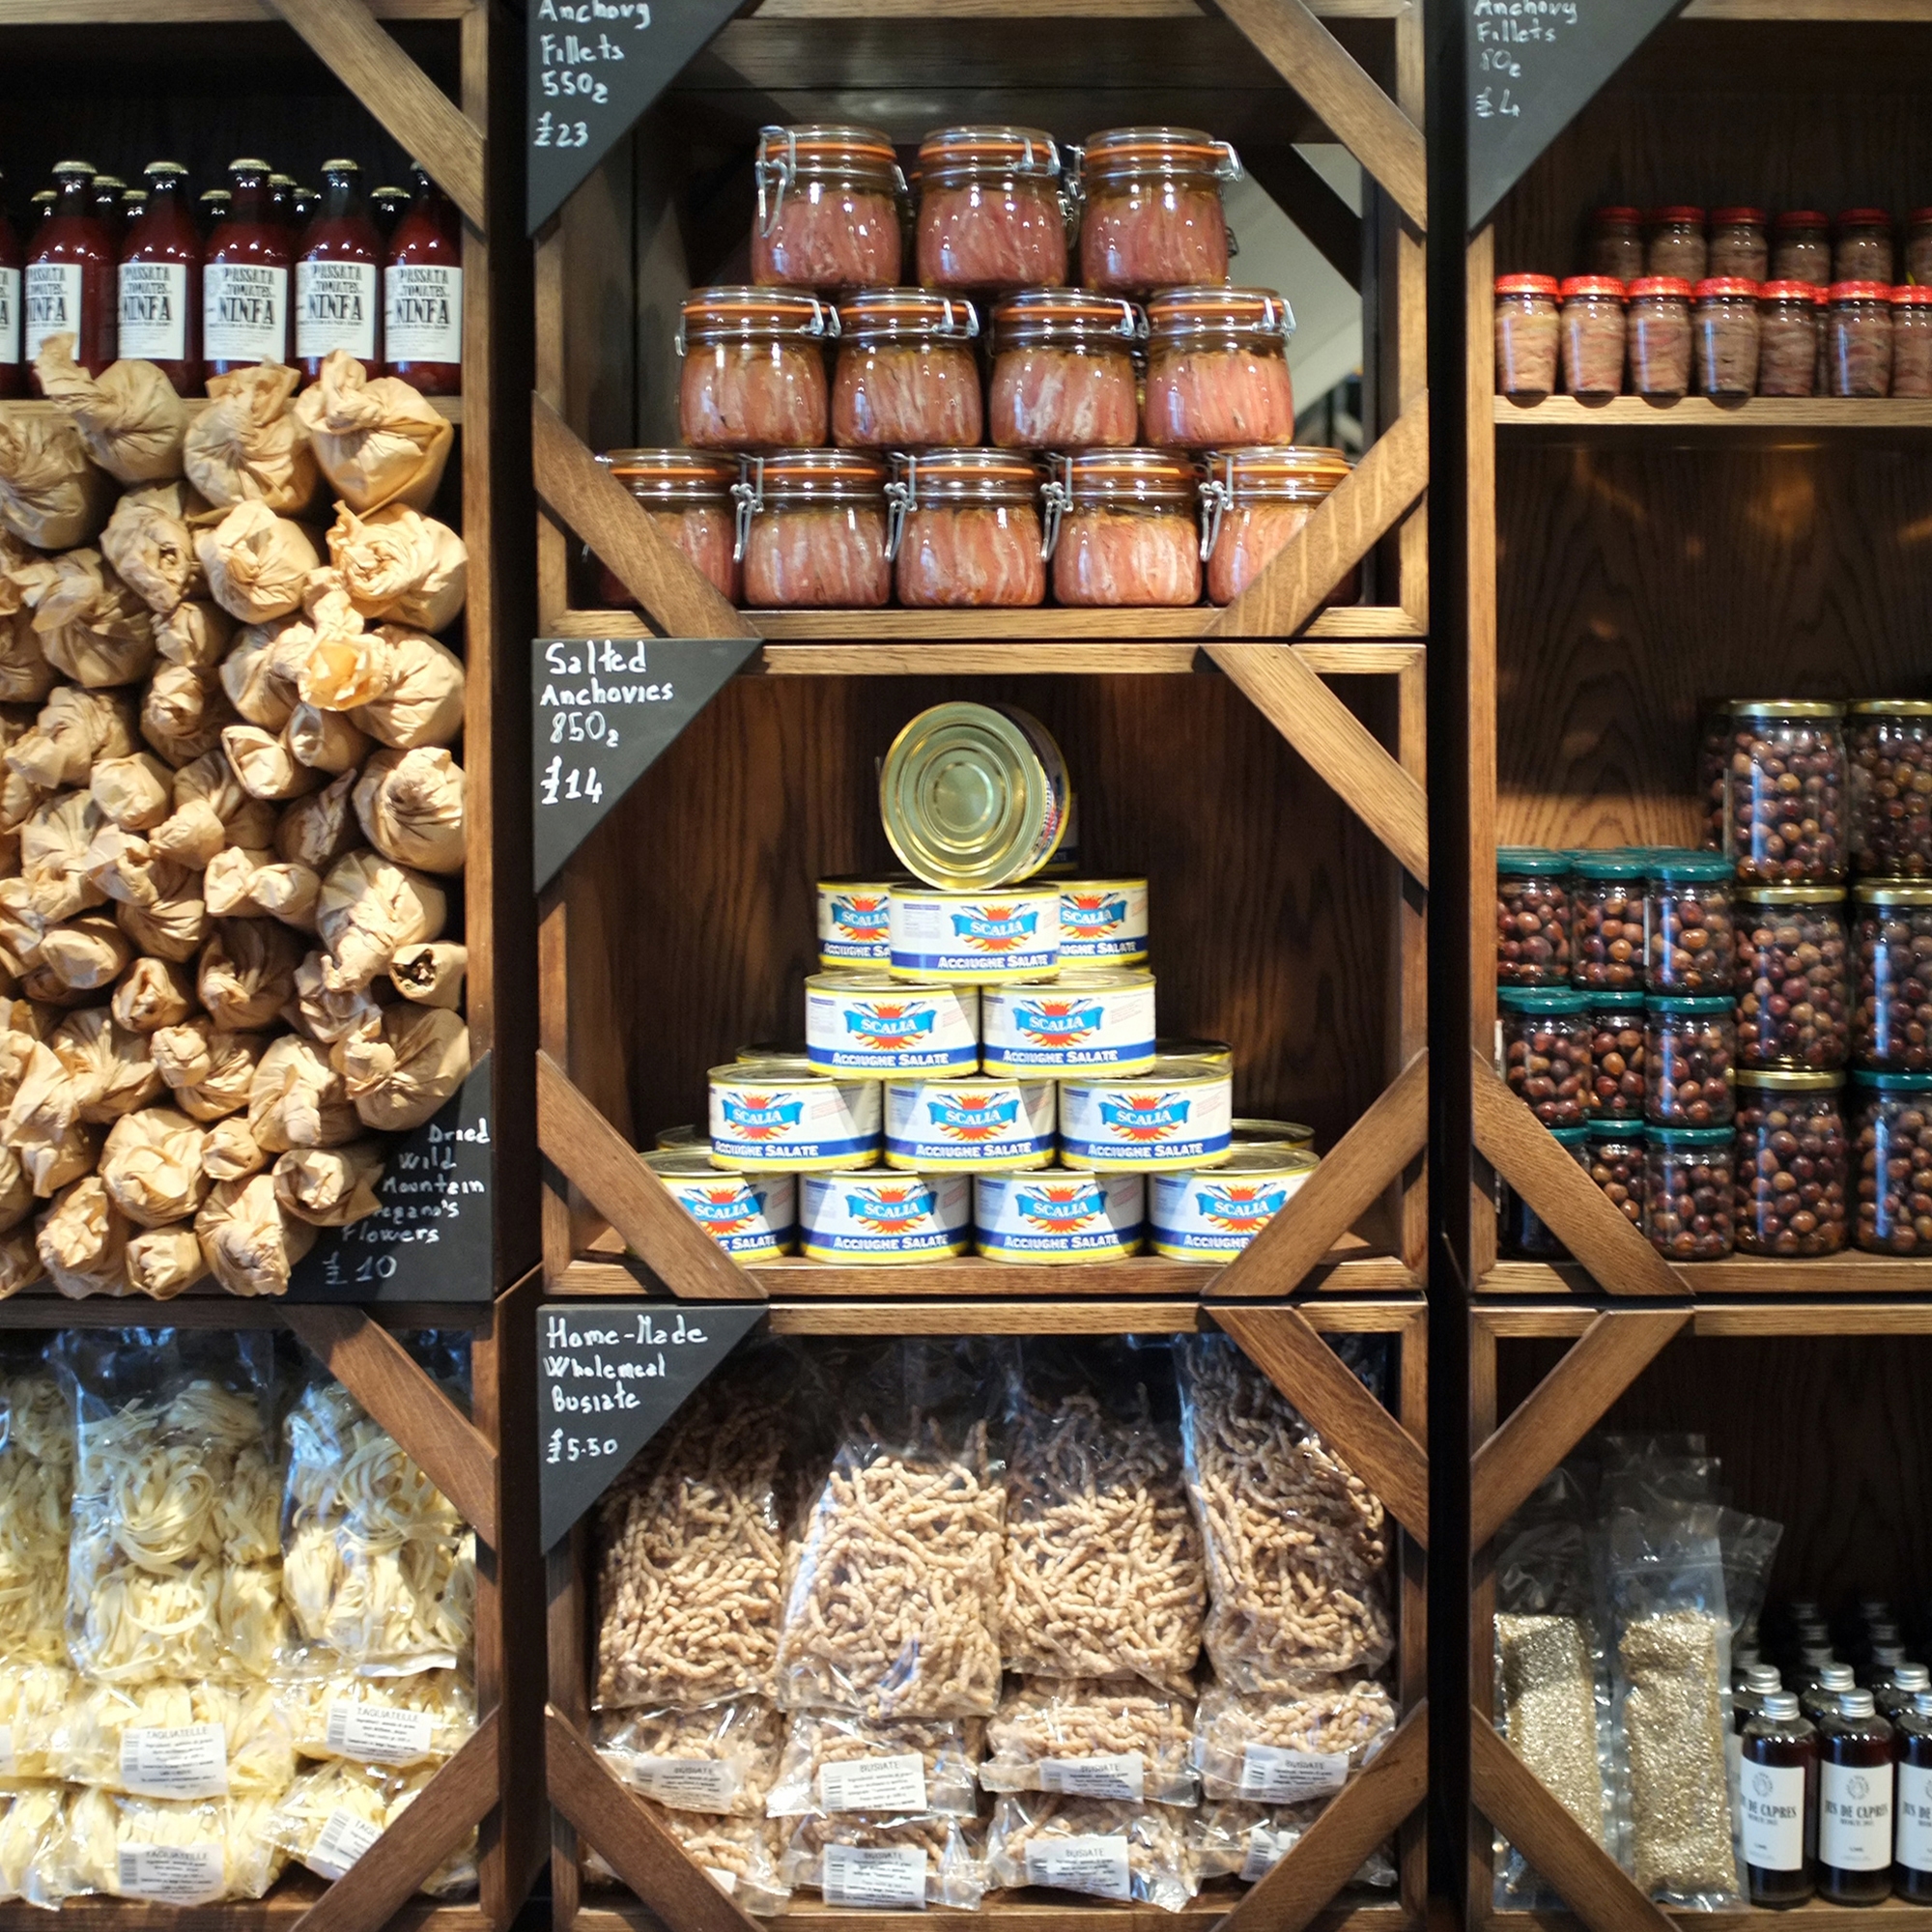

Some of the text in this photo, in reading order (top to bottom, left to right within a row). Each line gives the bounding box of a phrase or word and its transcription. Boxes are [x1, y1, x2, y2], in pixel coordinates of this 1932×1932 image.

[538, 0, 651, 30] Anchovy
[1474, 0, 1577, 25] Anchovy
[1477, 17, 1556, 43] Fillets
[540, 33, 625, 66] Fillets
[533, 110, 589, 148] £23
[218, 297, 275, 325] NINFA
[307, 294, 363, 321] NINFA
[395, 298, 450, 325] NINFA
[545, 639, 647, 675] Salted
[540, 677, 674, 707] Anchovies
[540, 755, 603, 806] £14
[841, 911, 890, 926] SCALIA
[970, 921, 1025, 938] SCALIA
[1062, 909, 1113, 924] SCALIA
[861, 1018, 917, 1035] SCALIA
[1030, 1017, 1085, 1034] SCALIA
[732, 1109, 783, 1124] SCALIA
[946, 1109, 1002, 1125] SCALIA
[1116, 1109, 1173, 1125] SCALIA
[427, 1117, 491, 1145] Dried
[398, 1146, 458, 1170] Wild
[382, 1173, 486, 1195] Mountain
[374, 1199, 460, 1225] regano's
[694, 1203, 750, 1219] SCALIA
[864, 1202, 921, 1217] SCALIA
[1033, 1201, 1089, 1217] SCALIA
[1214, 1200, 1270, 1217] SCALIA
[342, 1221, 440, 1244] Flowers
[323, 1251, 397, 1285] £10
[546, 1314, 708, 1350] Home-Made
[543, 1351, 666, 1379] Wholemeal
[551, 1379, 641, 1414] Busiate
[546, 1428, 618, 1464] £5.50
